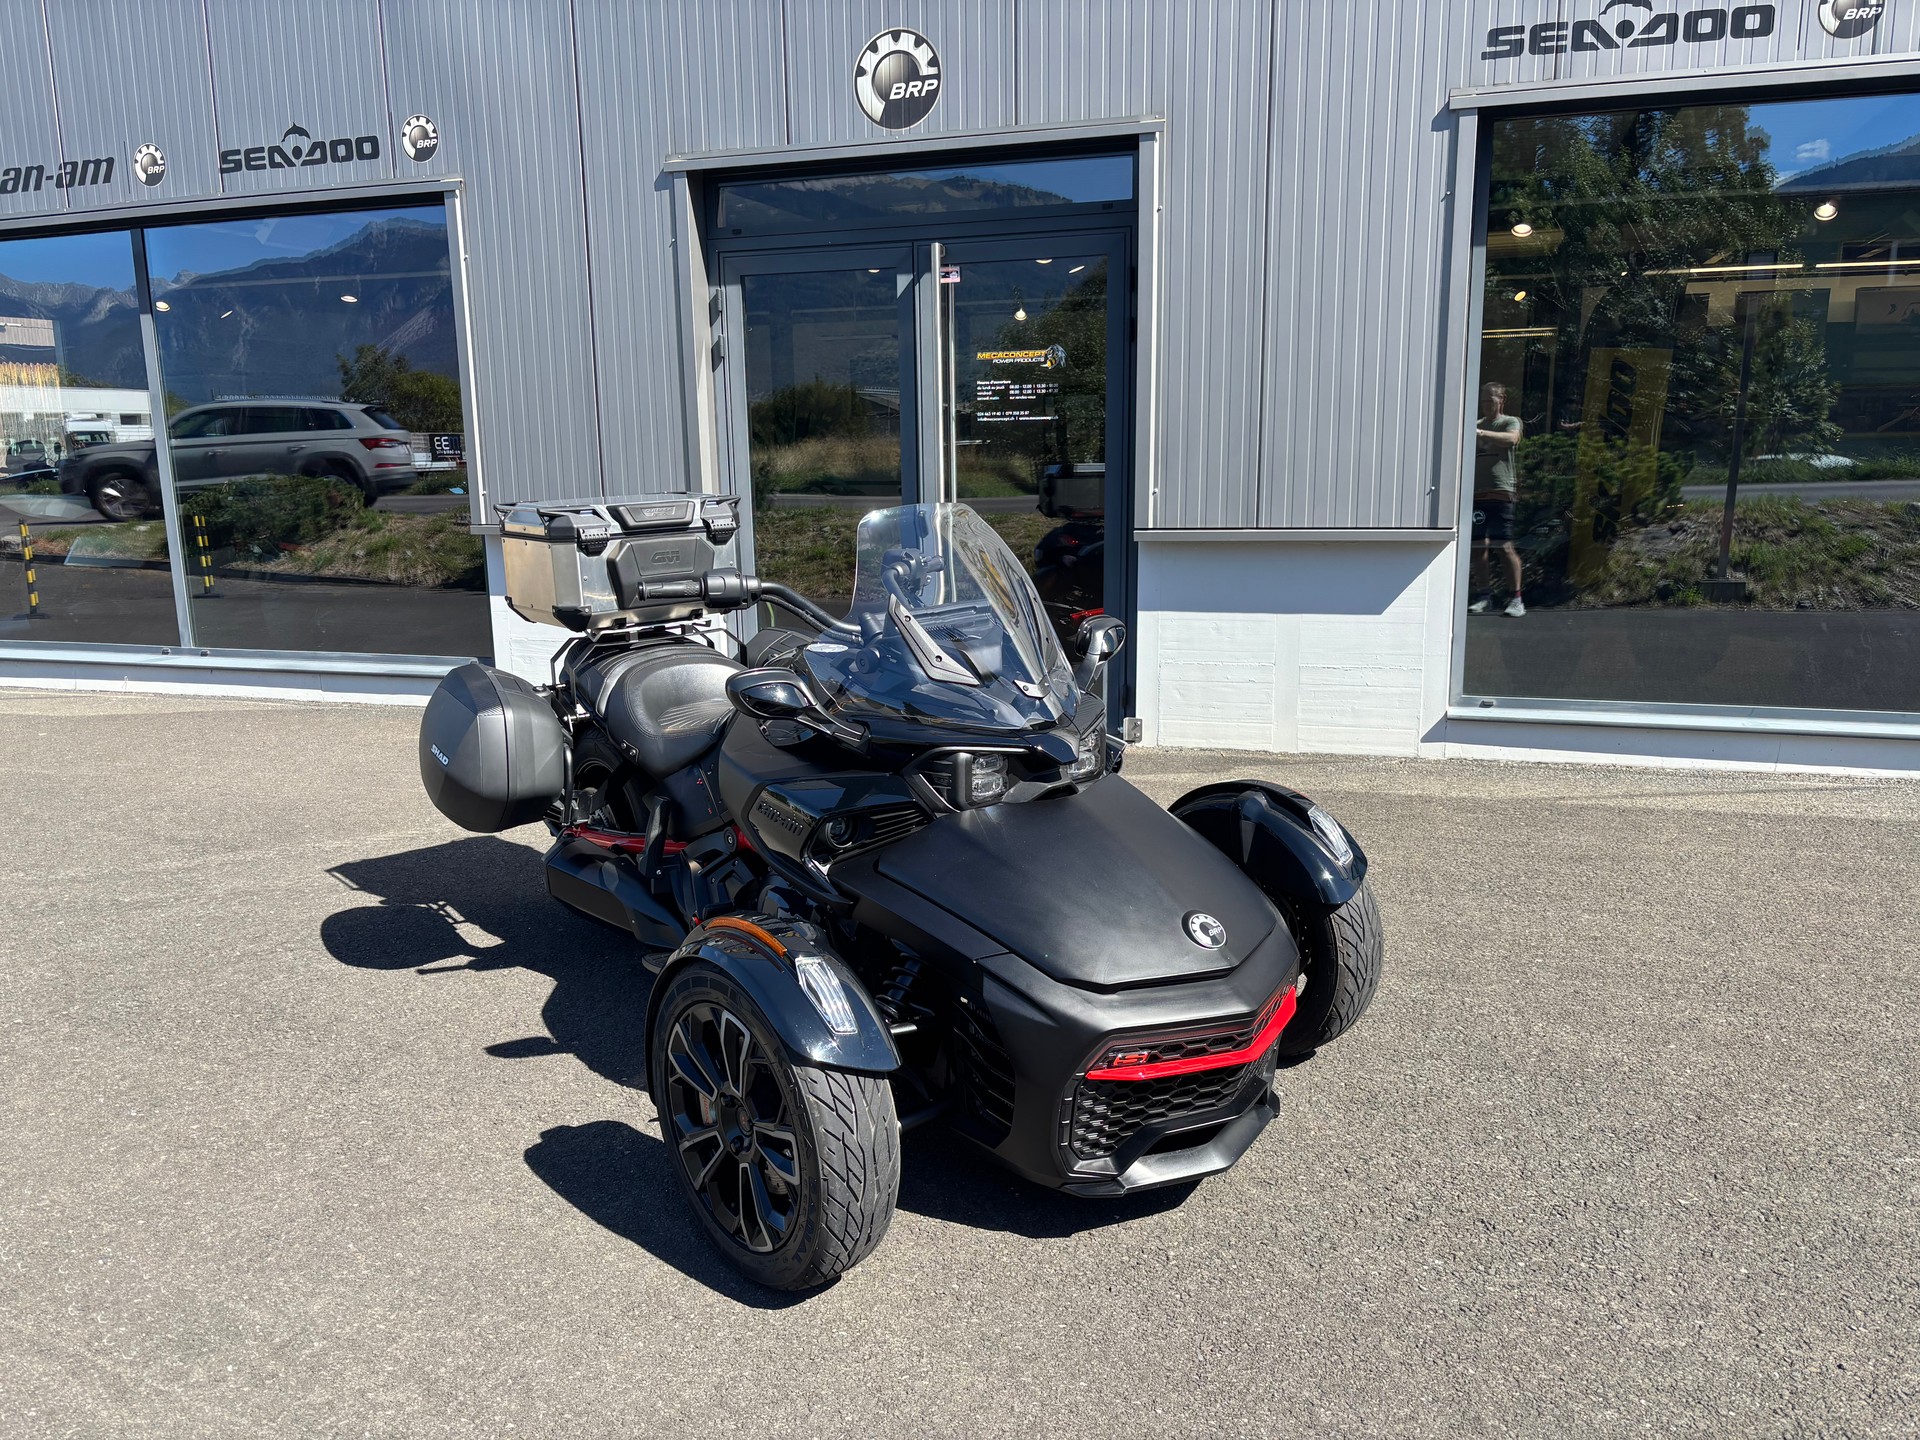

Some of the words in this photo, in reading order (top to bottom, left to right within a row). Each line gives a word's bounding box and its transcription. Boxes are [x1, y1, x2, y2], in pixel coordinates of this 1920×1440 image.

[1842, 5, 1883, 21] BRP
[888, 79, 939, 100] BRP
[415, 137, 438, 150] BRP
[146, 164, 165, 176] BRP
[976, 350, 1046, 360] MECACONCEPT
[430, 743, 449, 766] SHAD
[1208, 927, 1222, 937] BRP
